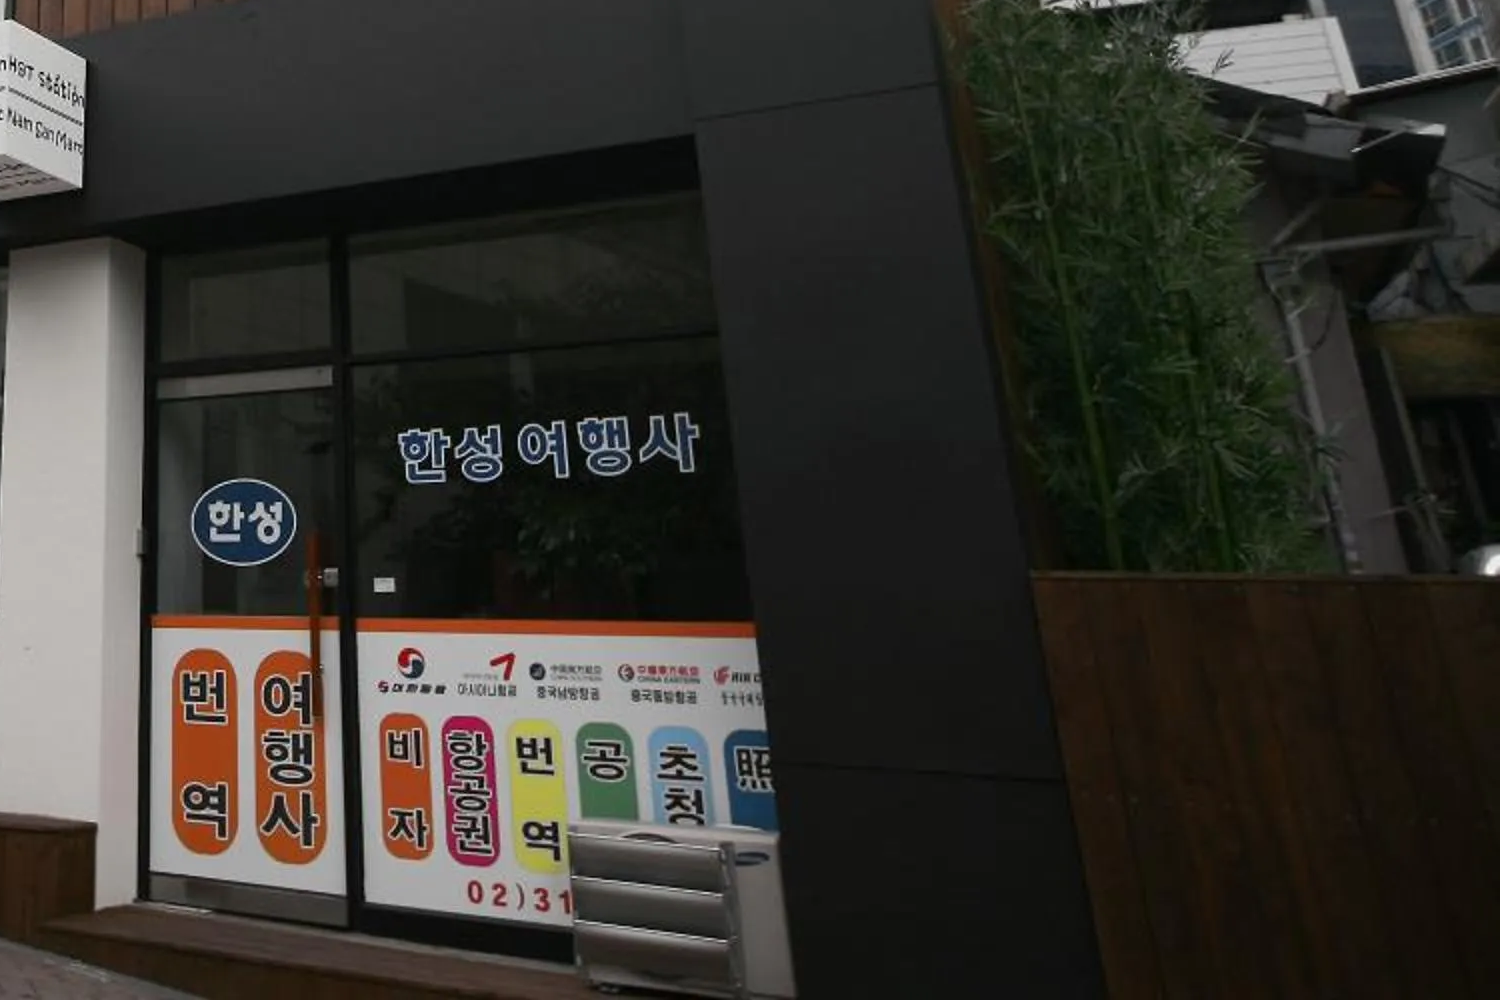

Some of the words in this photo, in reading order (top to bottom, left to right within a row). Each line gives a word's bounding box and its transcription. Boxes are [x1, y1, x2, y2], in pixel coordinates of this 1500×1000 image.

[36, 121, 54, 143] San
[398, 426, 502, 484] 한성
[517, 412, 700, 478] 여행사
[207, 499, 286, 545] 한성
[457, 682, 518, 698] 아시아나항공
[180, 670, 228, 840] 번역
[260, 673, 320, 849] 여행사
[386, 728, 430, 851] 비자
[441, 730, 494, 857] 항공권
[514, 734, 562, 862] 번역
[656, 743, 706, 827] 초청
